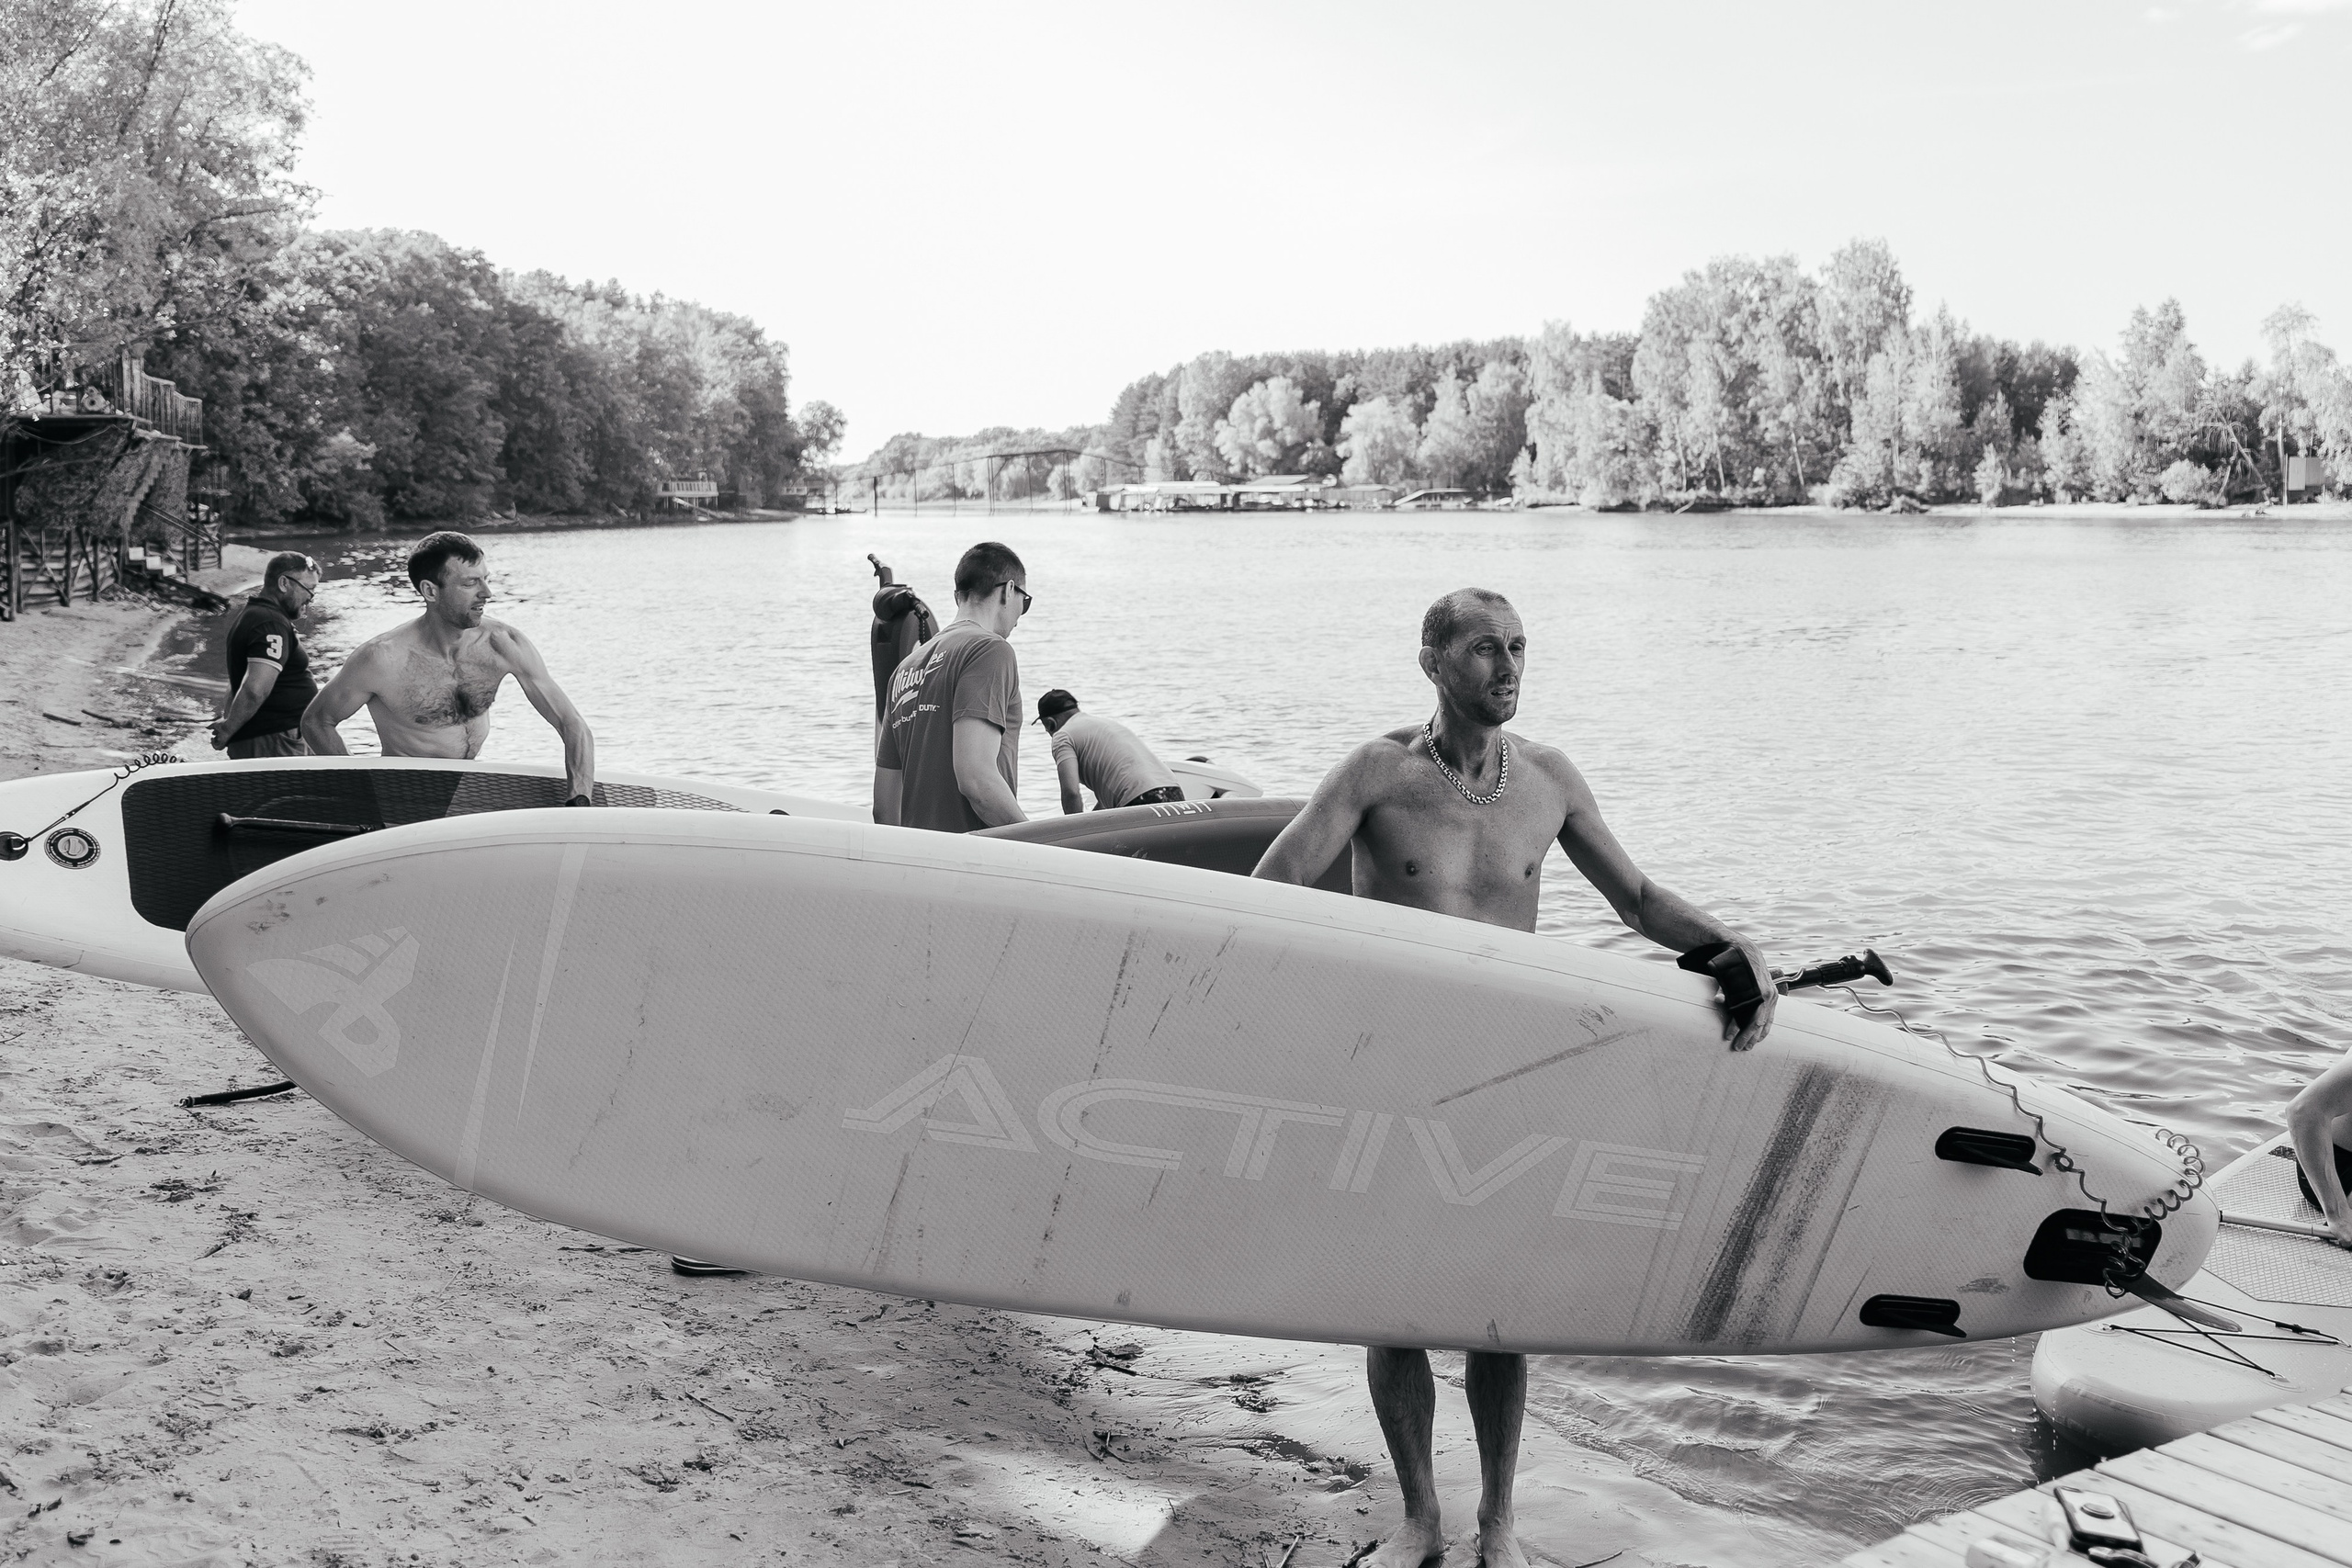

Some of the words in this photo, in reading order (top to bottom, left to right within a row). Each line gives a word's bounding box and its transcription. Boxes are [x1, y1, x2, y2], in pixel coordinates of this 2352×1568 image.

[266, 634, 283, 660] 3
[891, 650, 945, 704] Milwee
[1149, 801, 1212, 818] ITIWIT
[842, 1053, 1708, 1231] ACTIVE
